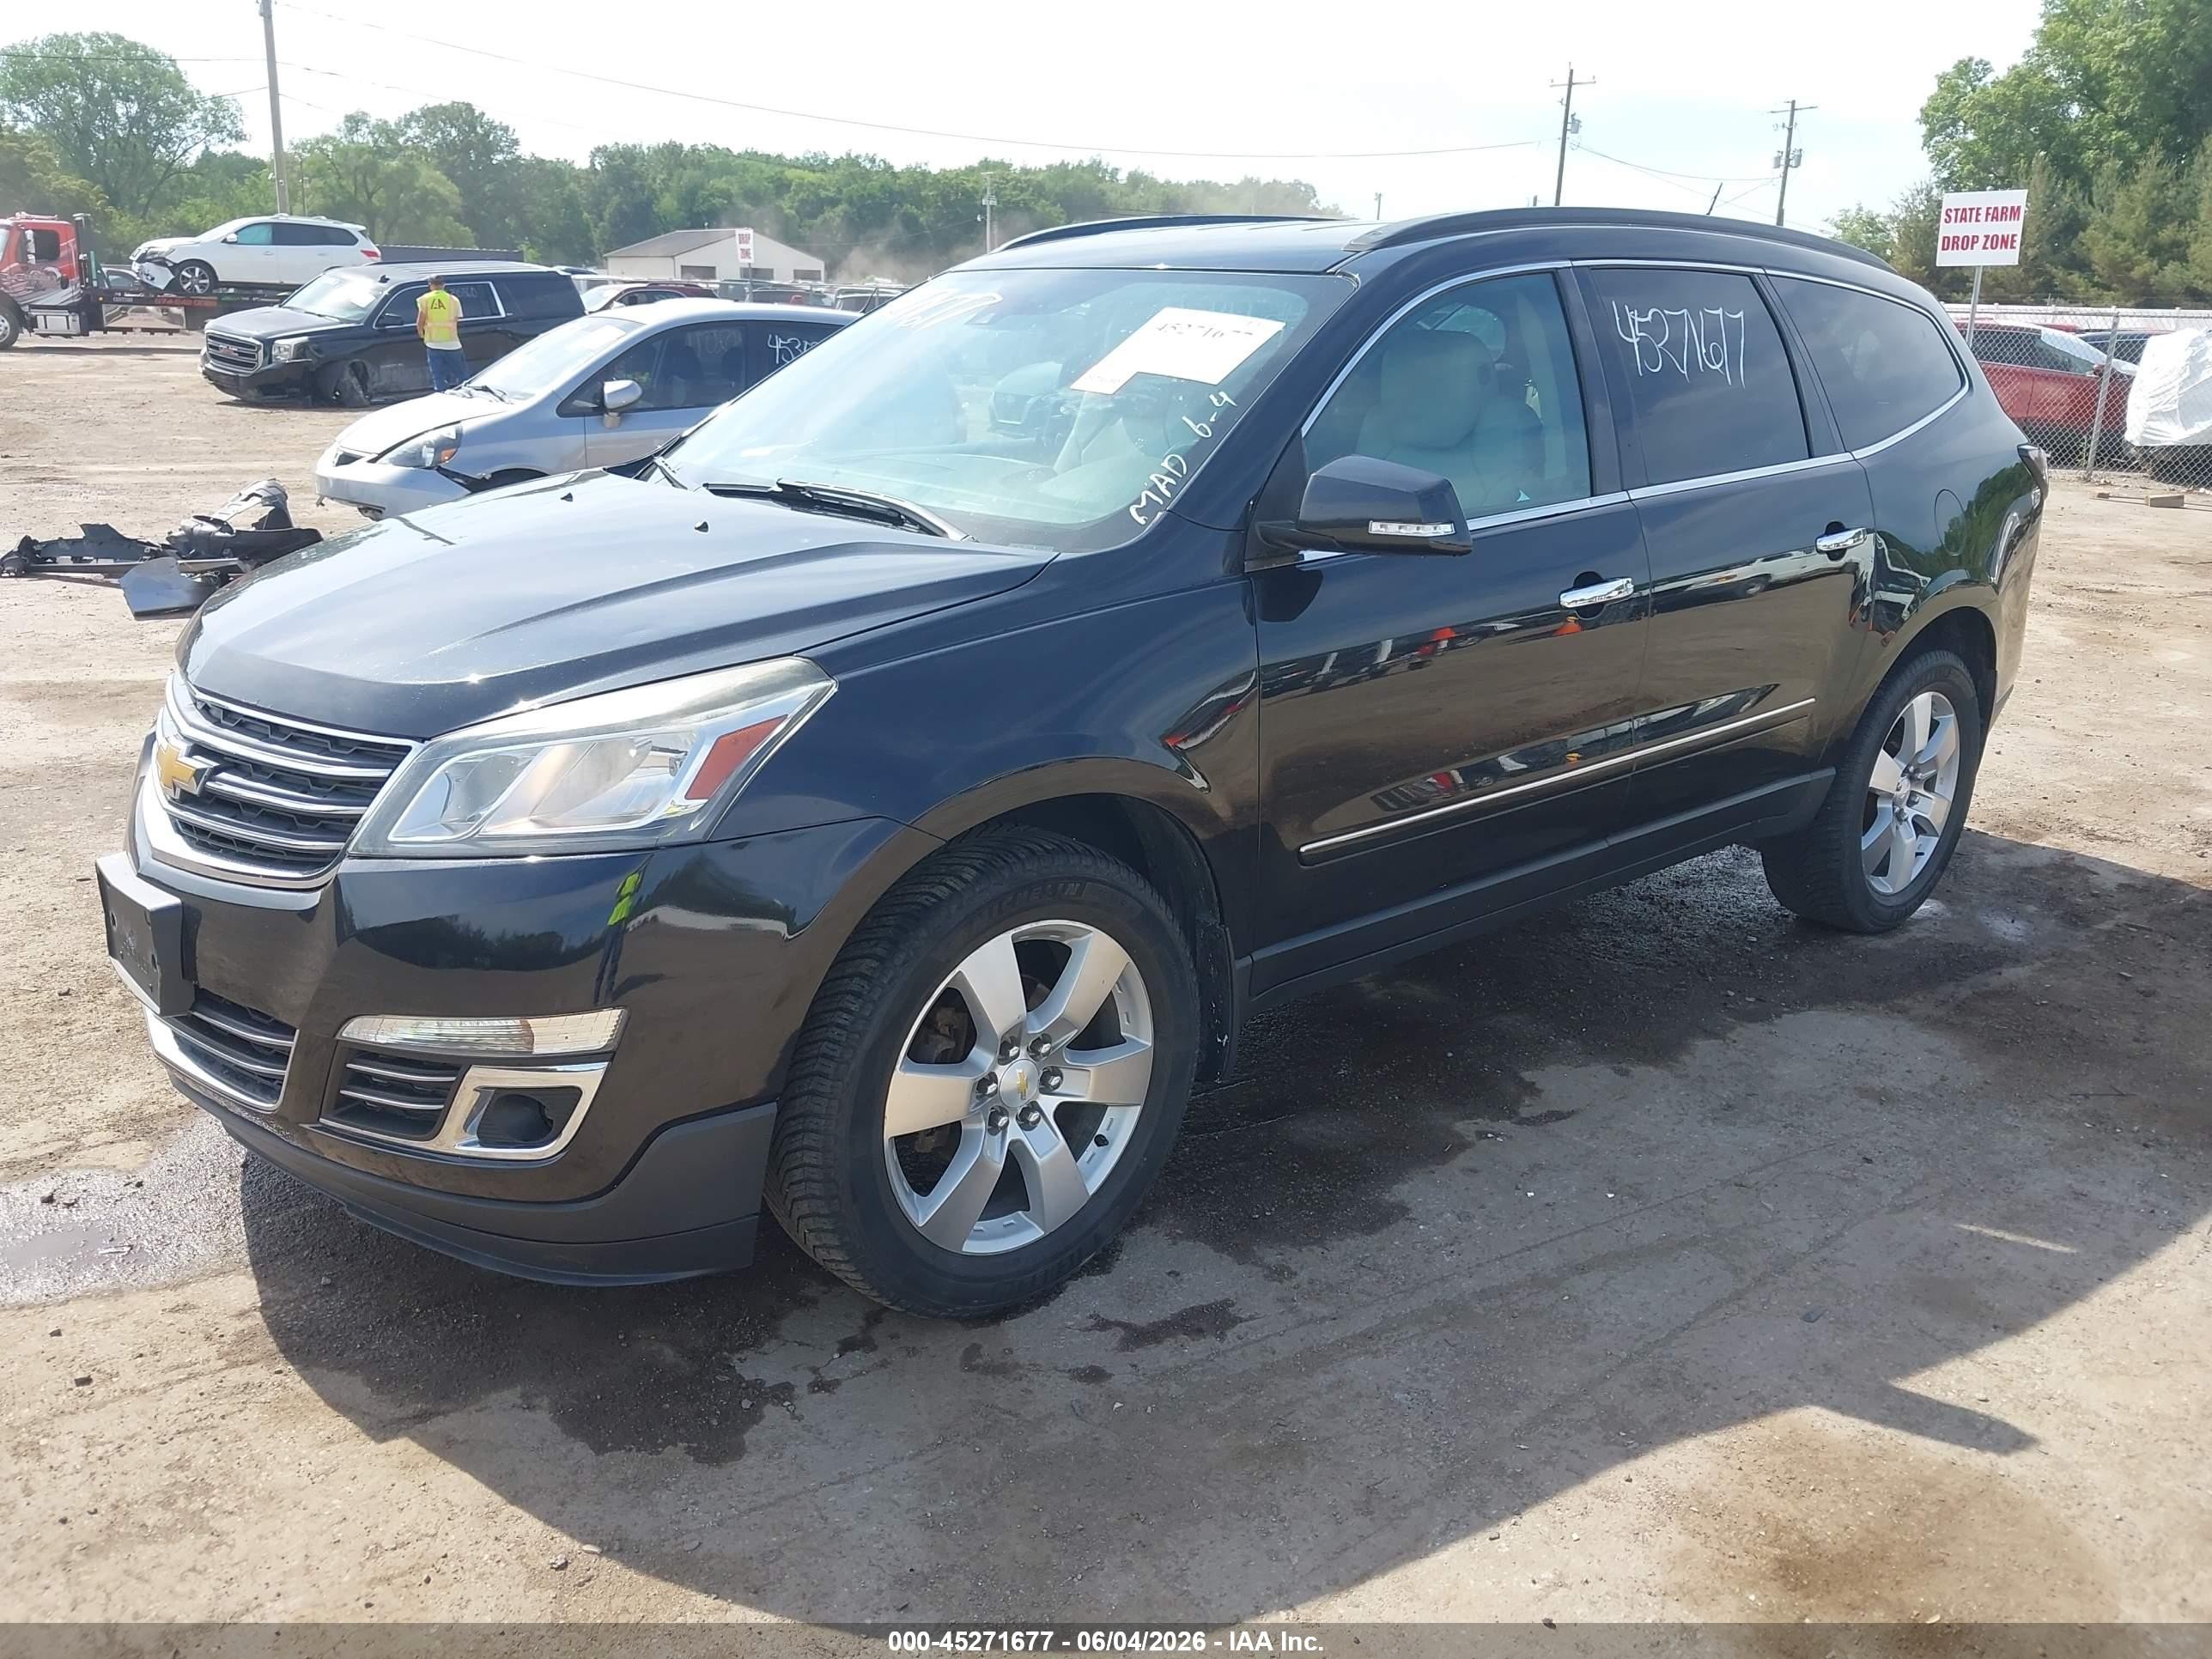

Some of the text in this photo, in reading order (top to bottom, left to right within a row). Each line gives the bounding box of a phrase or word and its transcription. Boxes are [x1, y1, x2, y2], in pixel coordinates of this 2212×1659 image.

[1944, 205, 2021, 224] STATE FARM
[1941, 233, 2019, 252] DROP ZONE
[1612, 300, 1746, 389] 45271677
[1129, 453, 1188, 526] MAD
